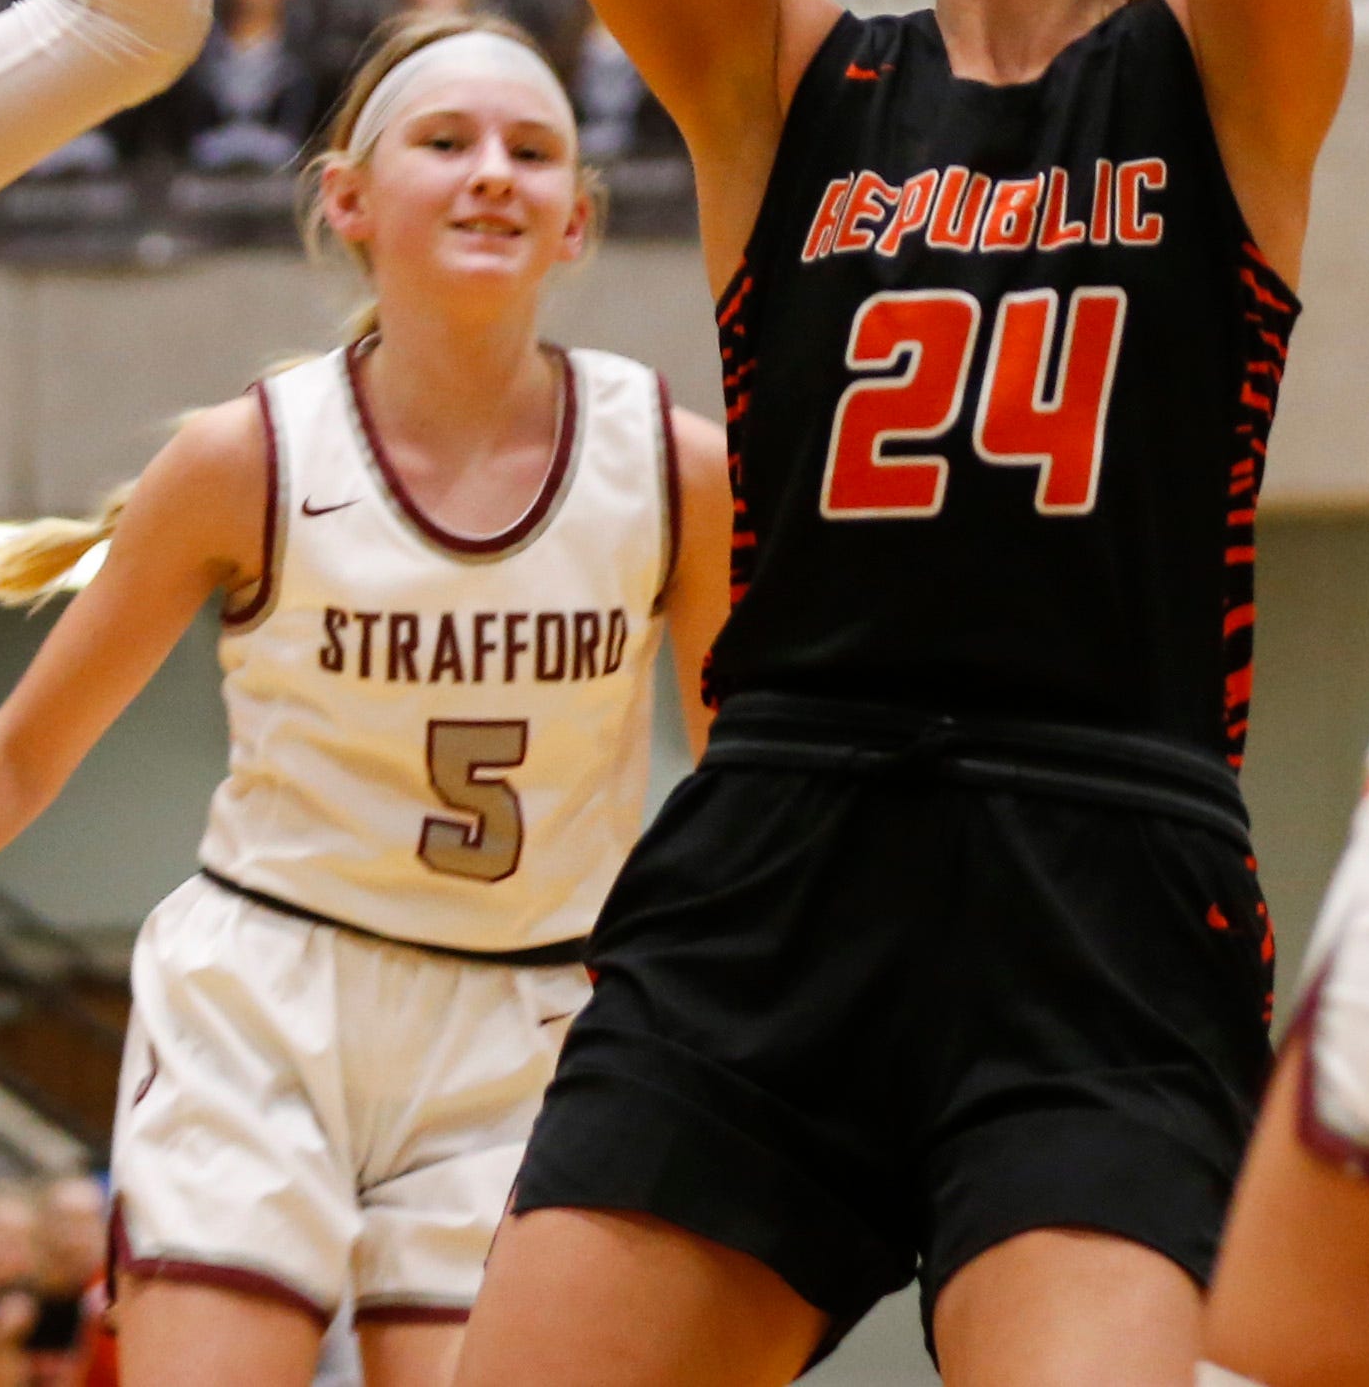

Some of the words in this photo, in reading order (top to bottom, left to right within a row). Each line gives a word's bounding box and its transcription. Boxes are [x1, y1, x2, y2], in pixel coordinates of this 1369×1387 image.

[801, 156, 1168, 264] REPUBLIC
[819, 285, 1128, 521] 24
[318, 606, 629, 684] STRAFFORD
[416, 719, 529, 884] 5
